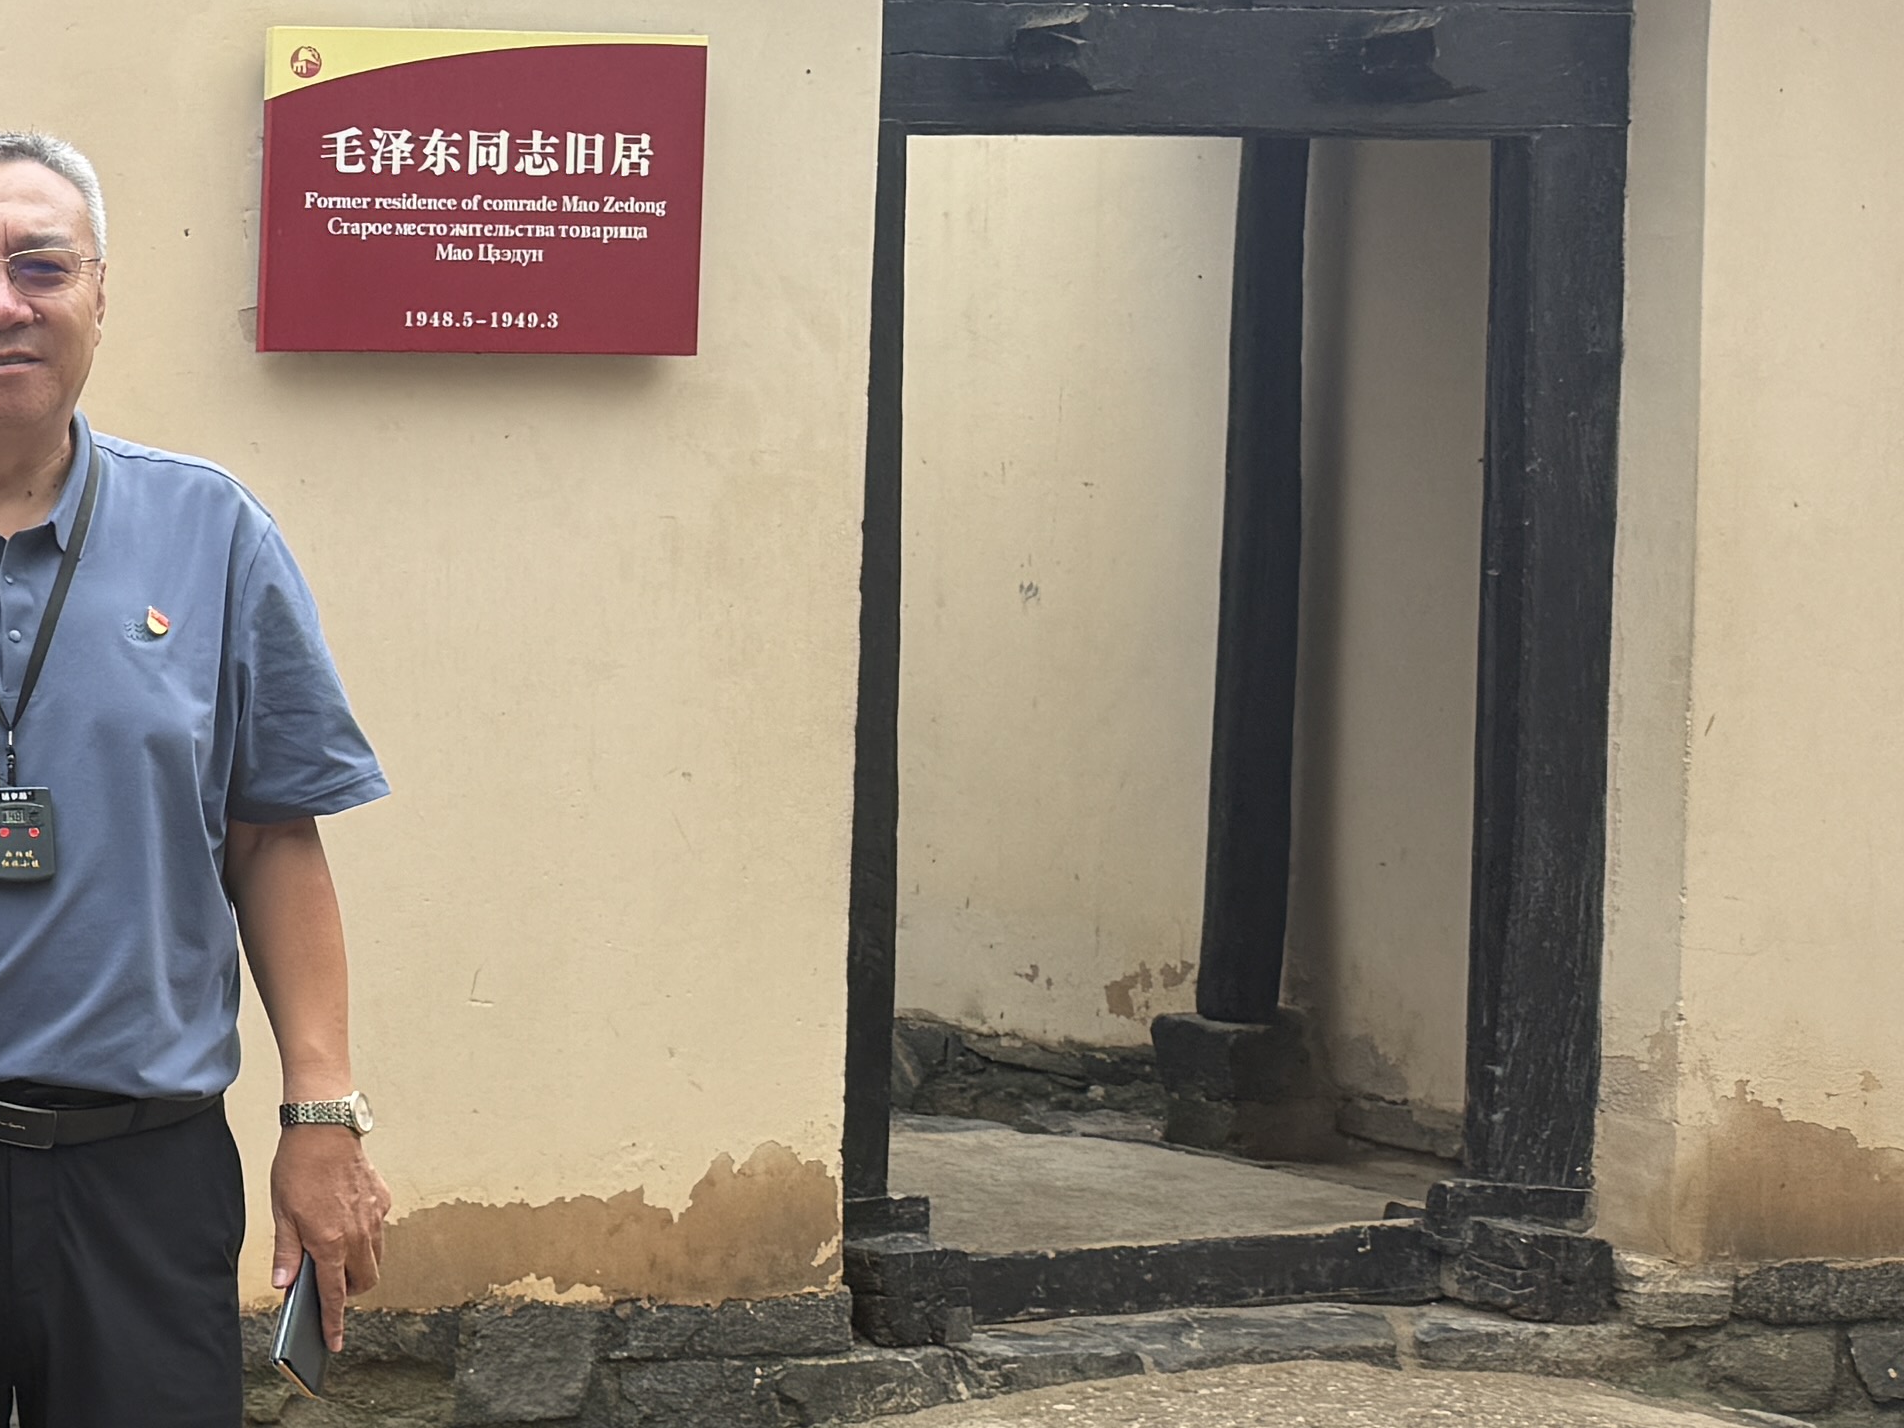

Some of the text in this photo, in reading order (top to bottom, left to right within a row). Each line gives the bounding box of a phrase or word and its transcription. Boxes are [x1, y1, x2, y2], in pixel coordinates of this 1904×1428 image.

[320, 126, 654, 177] 毛泽东同志旧居
[304, 191, 667, 217] Former residence of comrade Mao Zedong
[327, 217, 648, 243] Старое место жительства товарища
[435, 243, 544, 267] Мао Цзэдун
